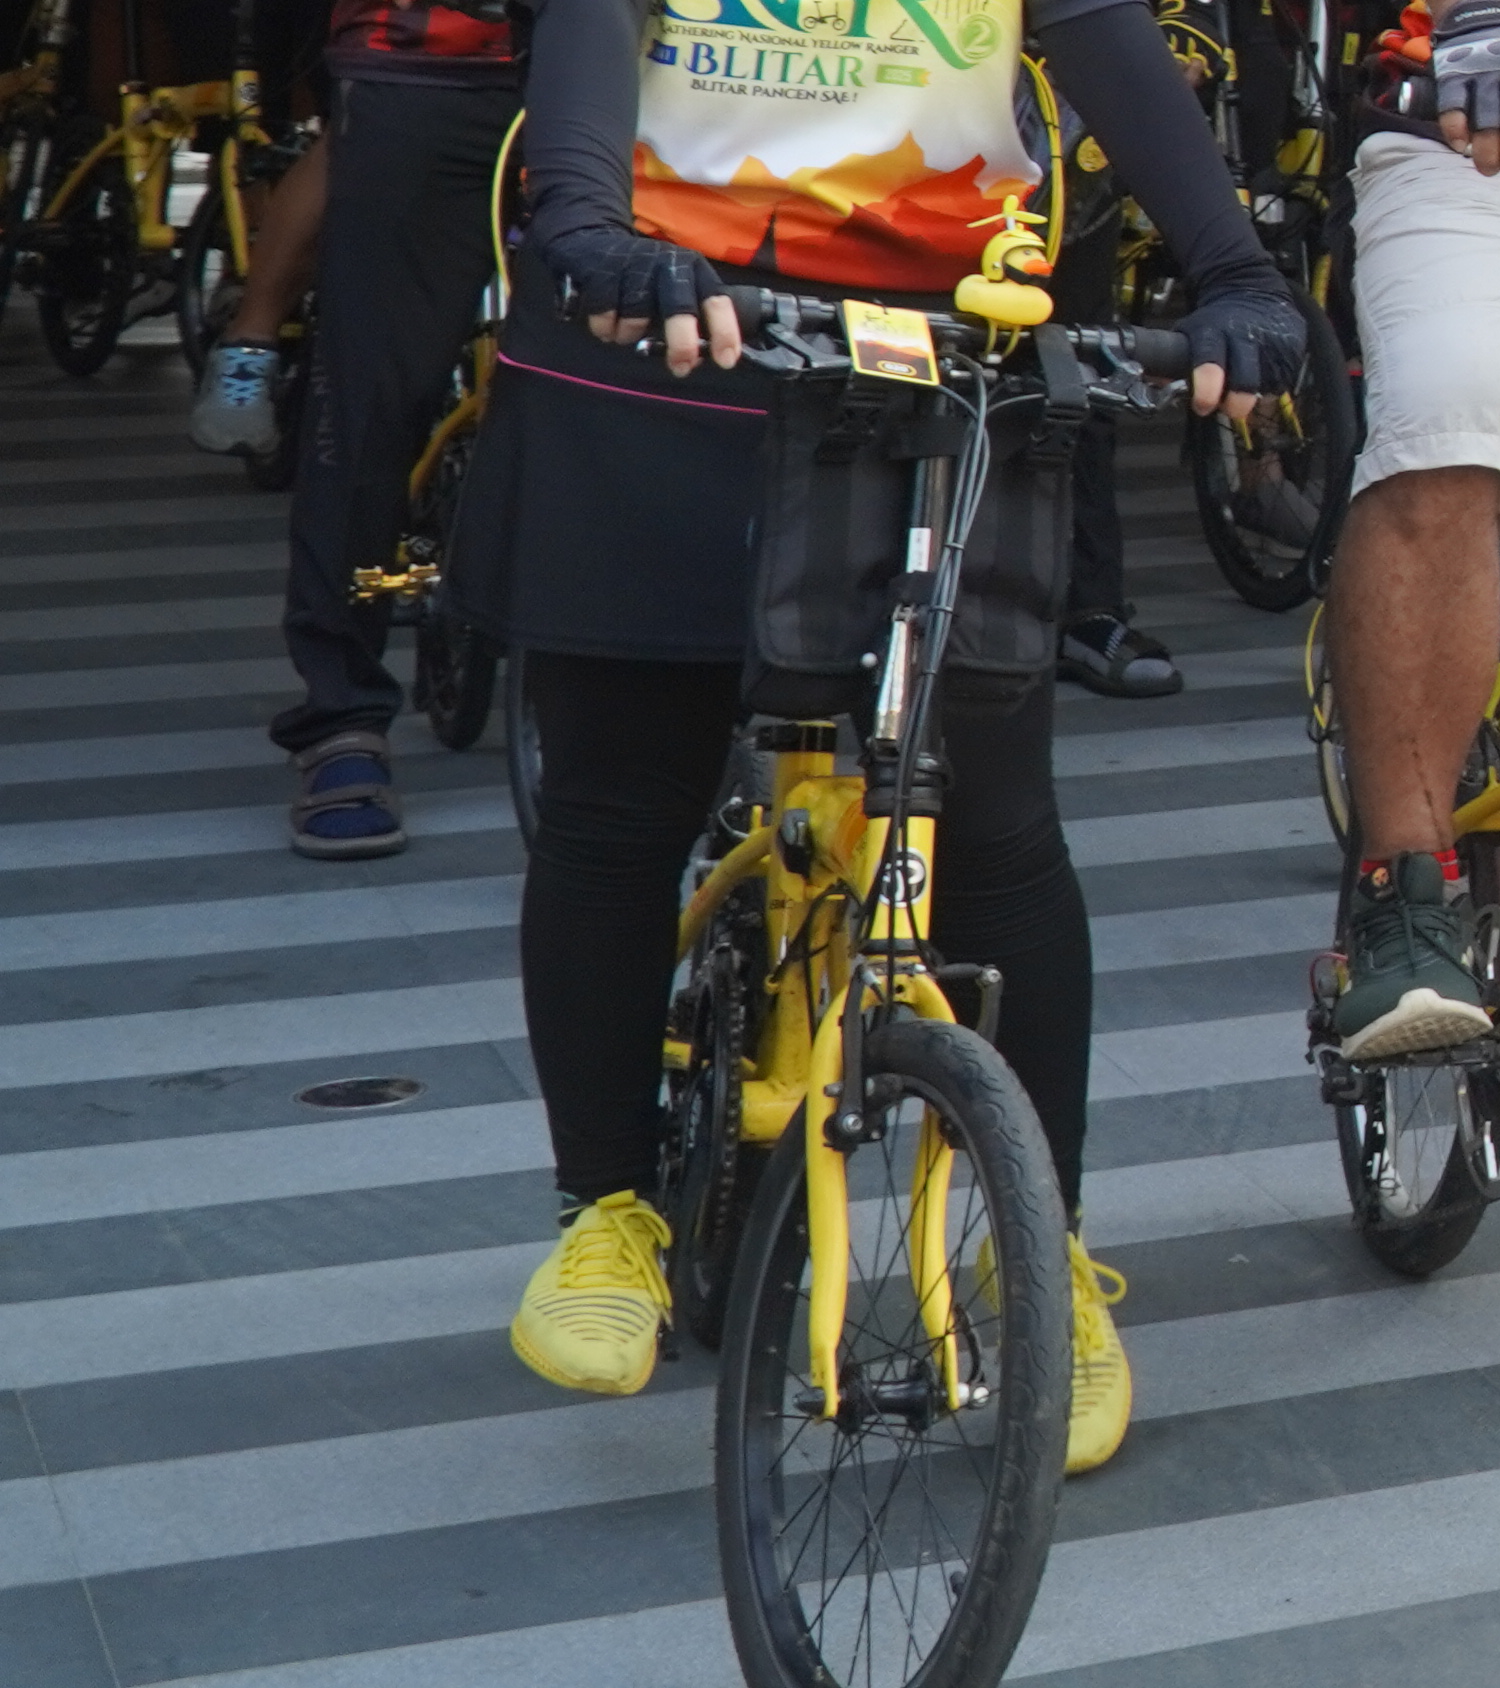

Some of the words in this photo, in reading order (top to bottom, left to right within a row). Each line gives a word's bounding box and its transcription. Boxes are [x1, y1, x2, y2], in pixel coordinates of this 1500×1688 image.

[738, 28, 807, 48] NASIONAL
[811, 36, 863, 51] YELLOW
[866, 43, 920, 56] RANGER
[684, 41, 867, 88] BLITAR
[690, 78, 748, 97] BLITAR
[752, 85, 817, 103] PANCEN
[820, 90, 850, 105] SAE
